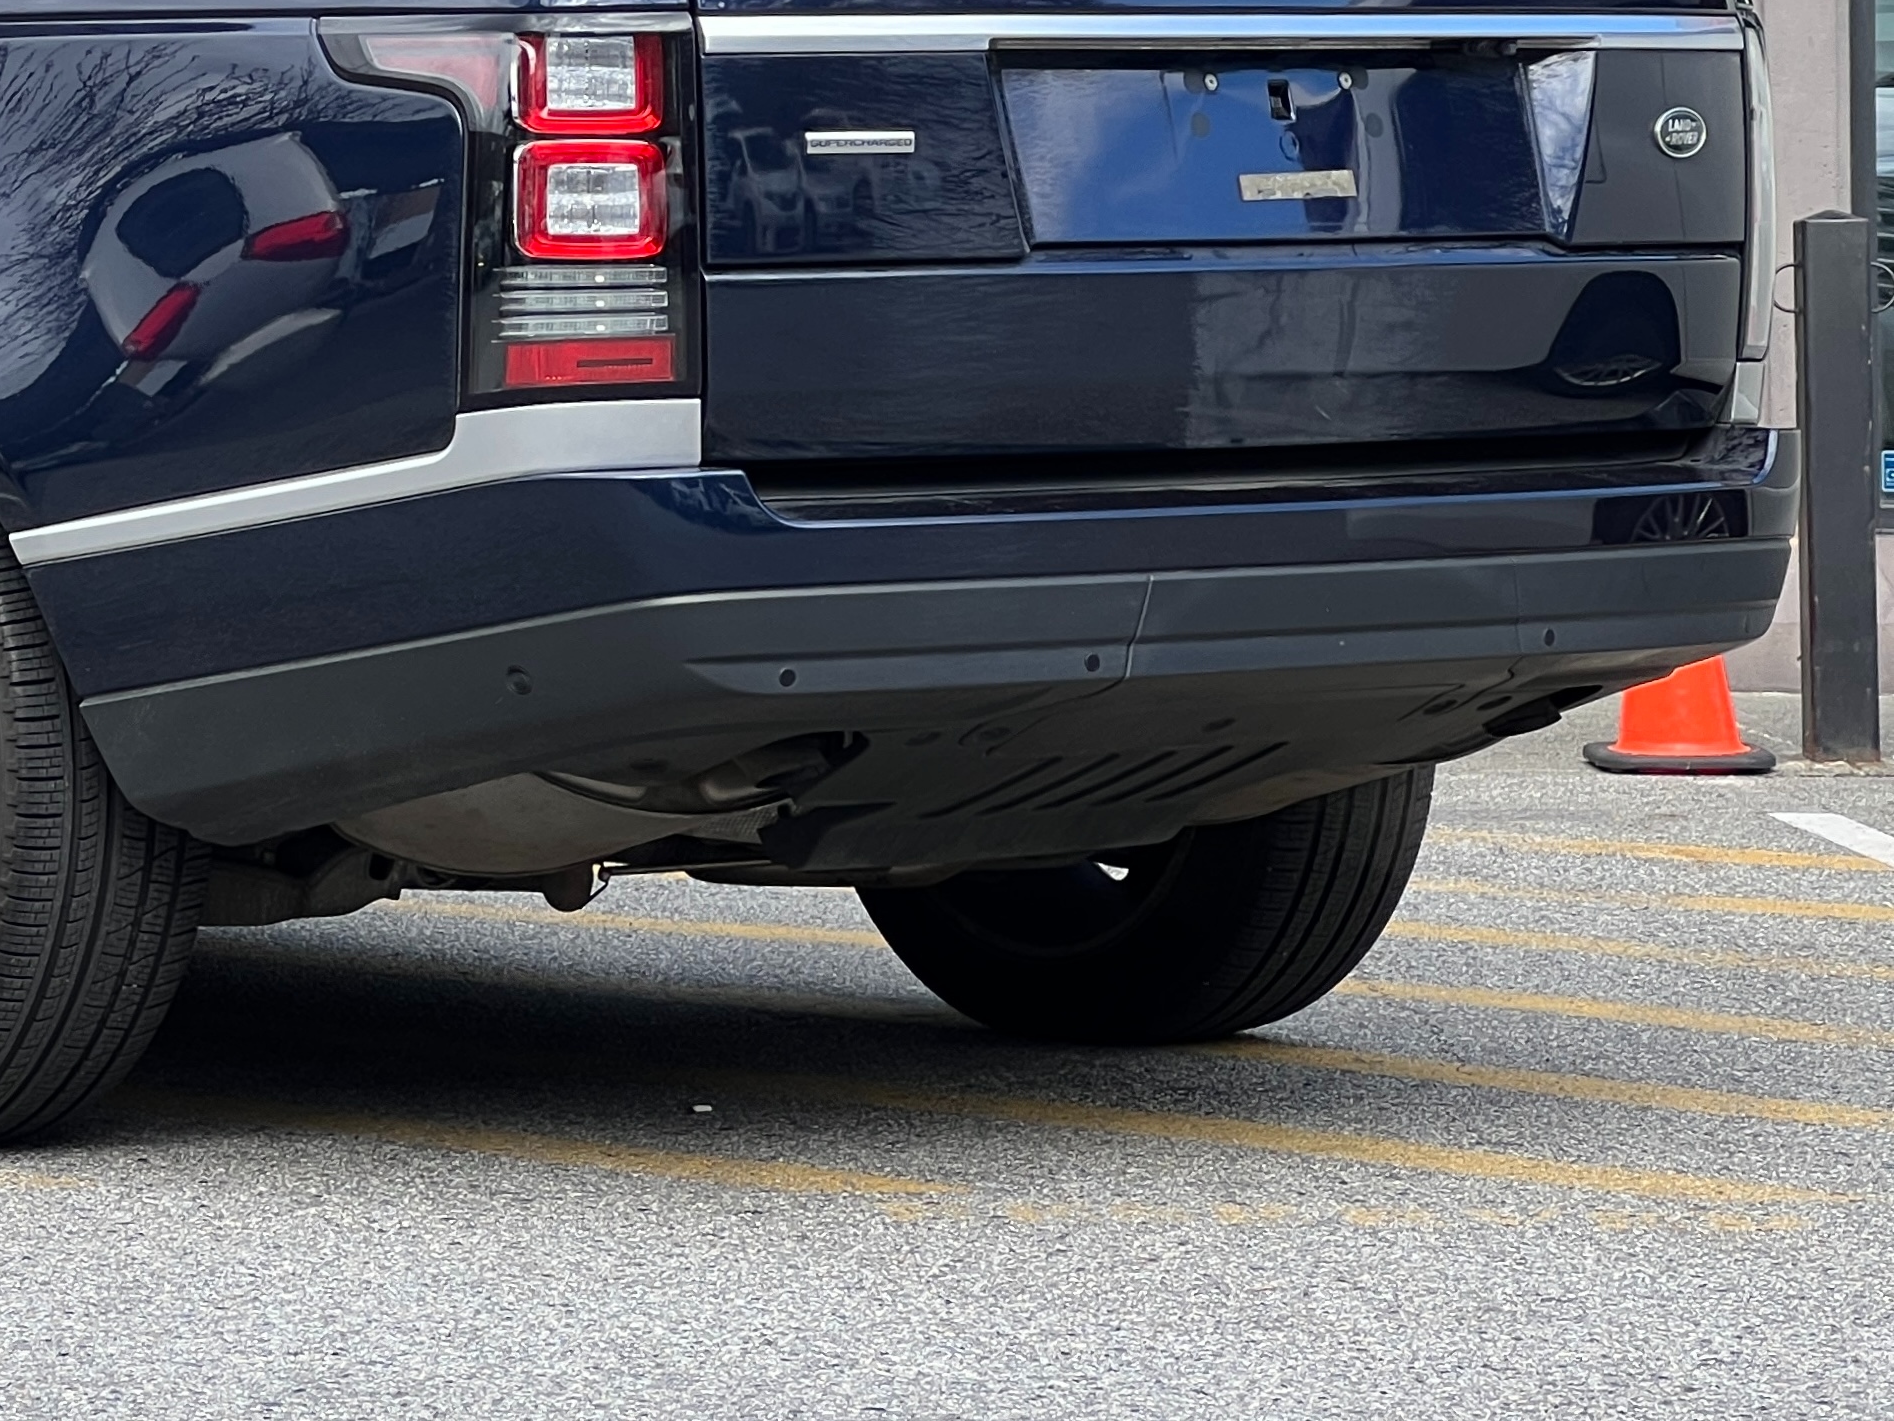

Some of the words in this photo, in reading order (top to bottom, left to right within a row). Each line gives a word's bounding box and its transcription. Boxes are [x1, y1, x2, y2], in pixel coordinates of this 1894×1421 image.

[1668, 119, 1692, 131] LAND
[810, 139, 912, 147] SUPERCHARGED
[1670, 132, 1699, 144] ROVER
